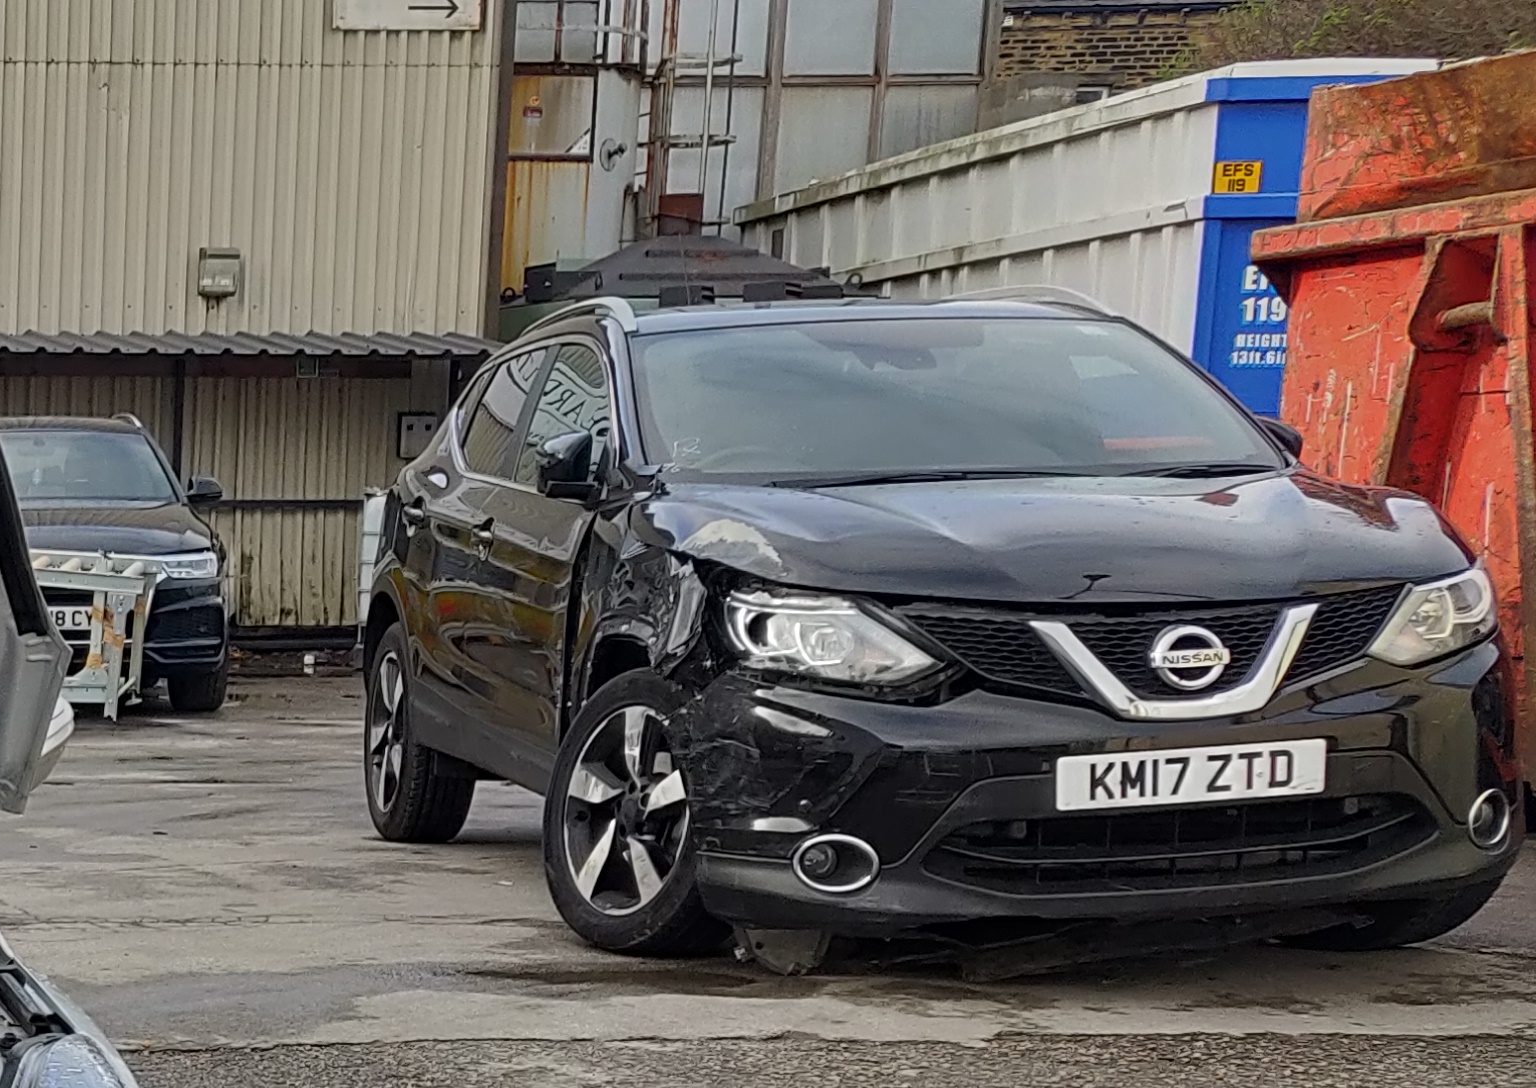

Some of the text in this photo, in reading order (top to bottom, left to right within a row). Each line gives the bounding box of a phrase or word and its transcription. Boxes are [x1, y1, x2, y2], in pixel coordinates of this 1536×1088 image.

[1222, 163, 1255, 177] EFS
[1227, 178, 1246, 192] 119
[1241, 296, 1287, 322] 119
[1162, 651, 1224, 665] NISSAN
[1089, 749, 1294, 801] KM17 ZTD
